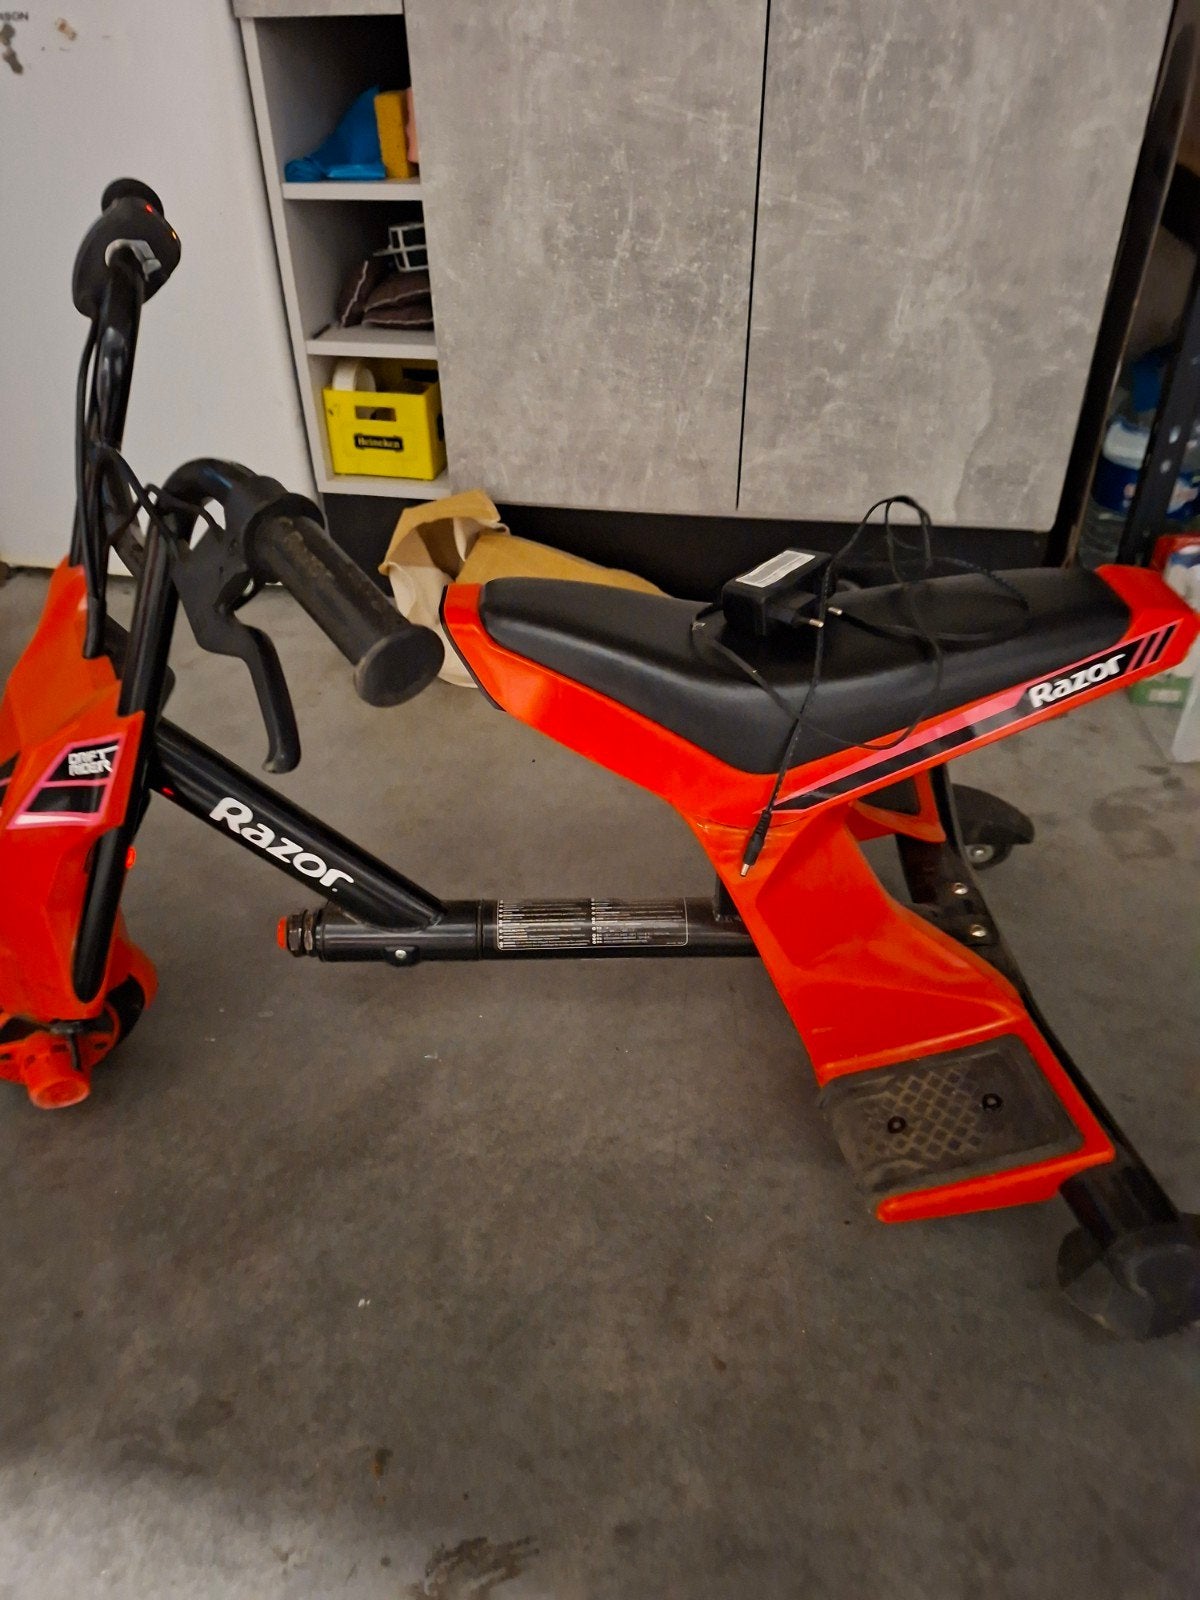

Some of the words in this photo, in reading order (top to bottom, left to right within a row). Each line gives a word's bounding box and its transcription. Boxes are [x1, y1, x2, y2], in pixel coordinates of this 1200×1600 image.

[357, 436, 401, 448] Heineken
[1028, 653, 1126, 708] Razor
[68, 745, 119, 764] DRIFT
[209, 797, 354, 888] Razor
